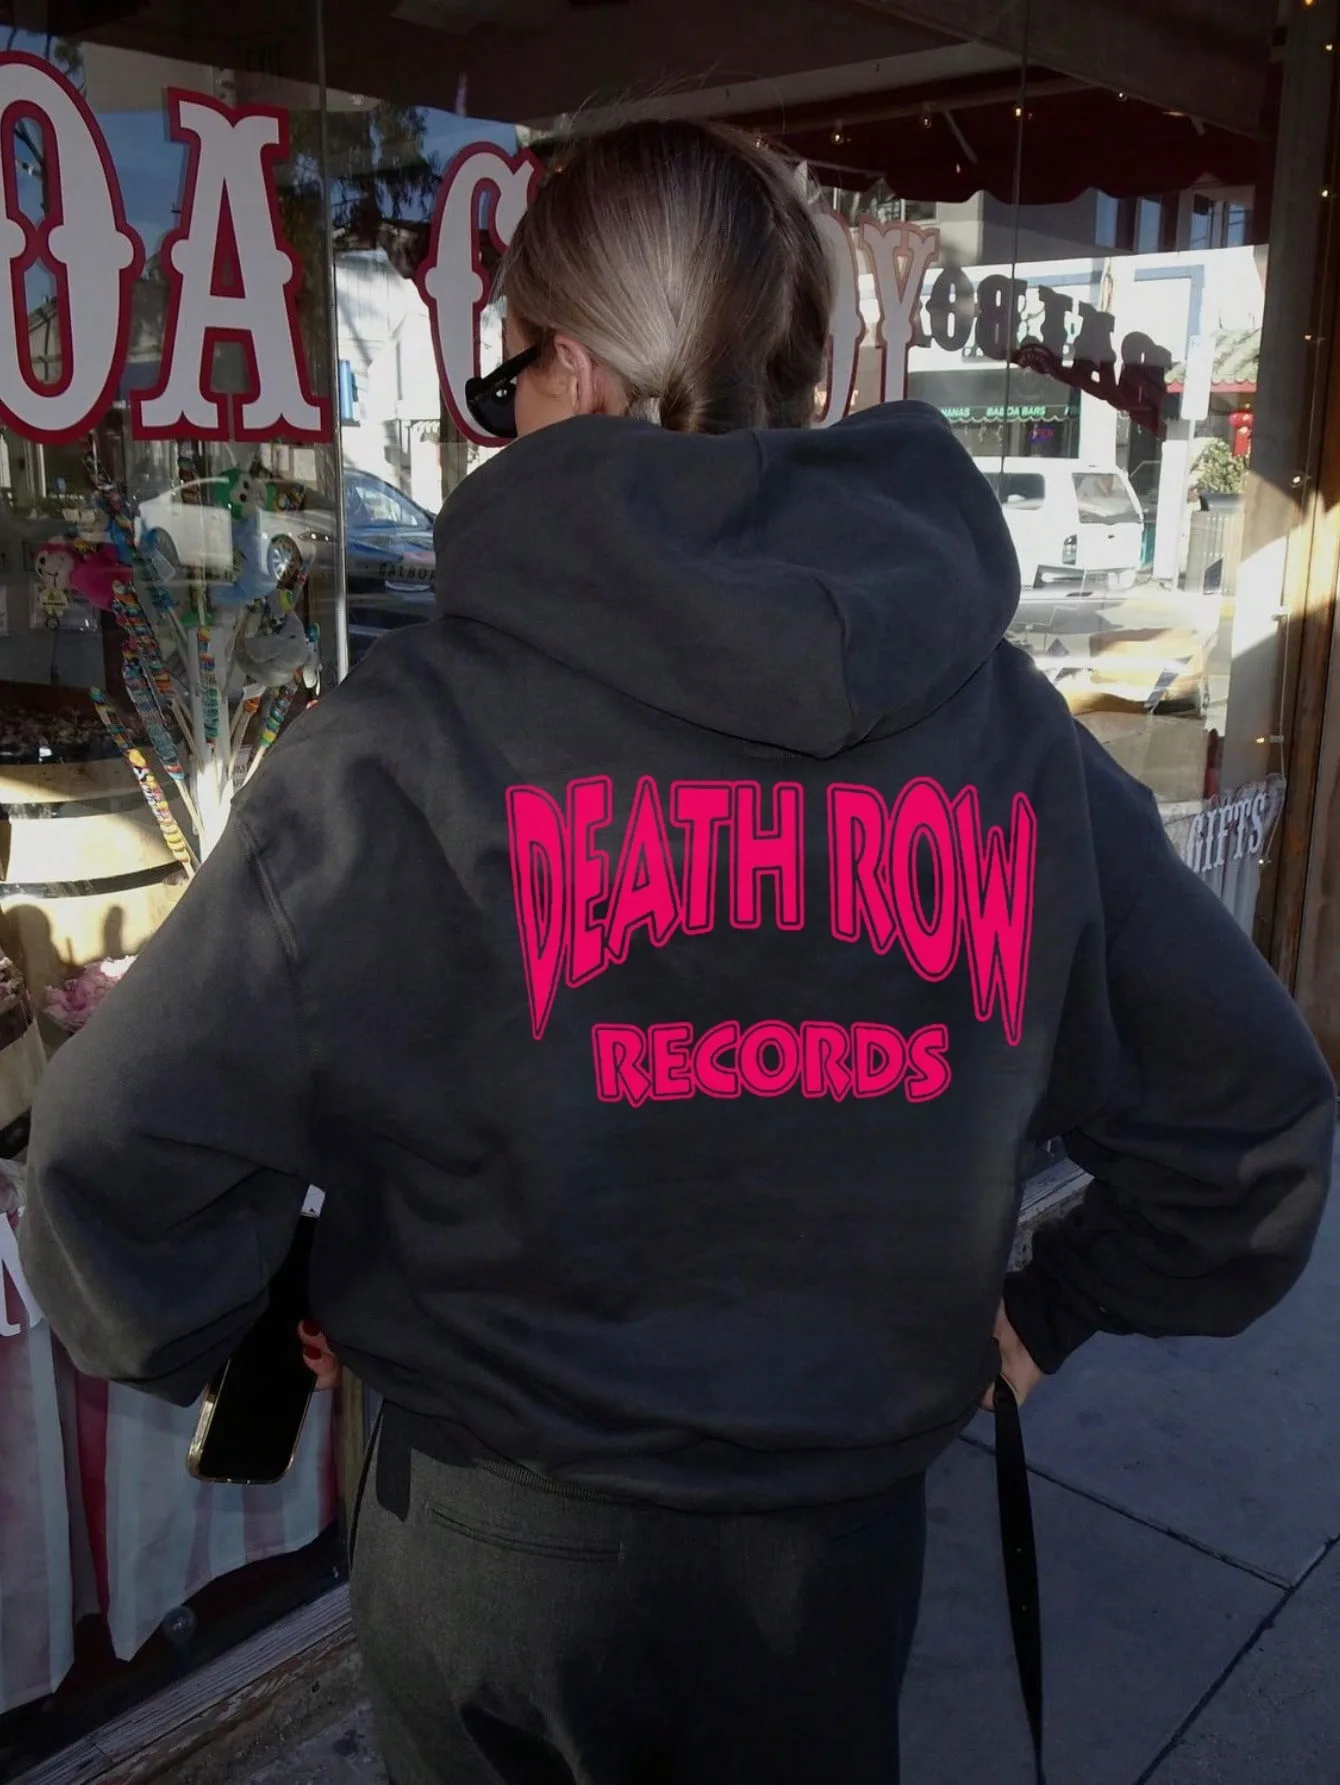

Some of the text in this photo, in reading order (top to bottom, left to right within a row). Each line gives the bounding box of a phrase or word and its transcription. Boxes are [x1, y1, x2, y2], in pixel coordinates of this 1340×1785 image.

[986, 406, 1019, 417] BALOA
[1187, 792, 1265, 873] GIFTS
[505, 775, 1037, 1046] DEATH ROW
[592, 1018, 951, 1107] RECORDS
